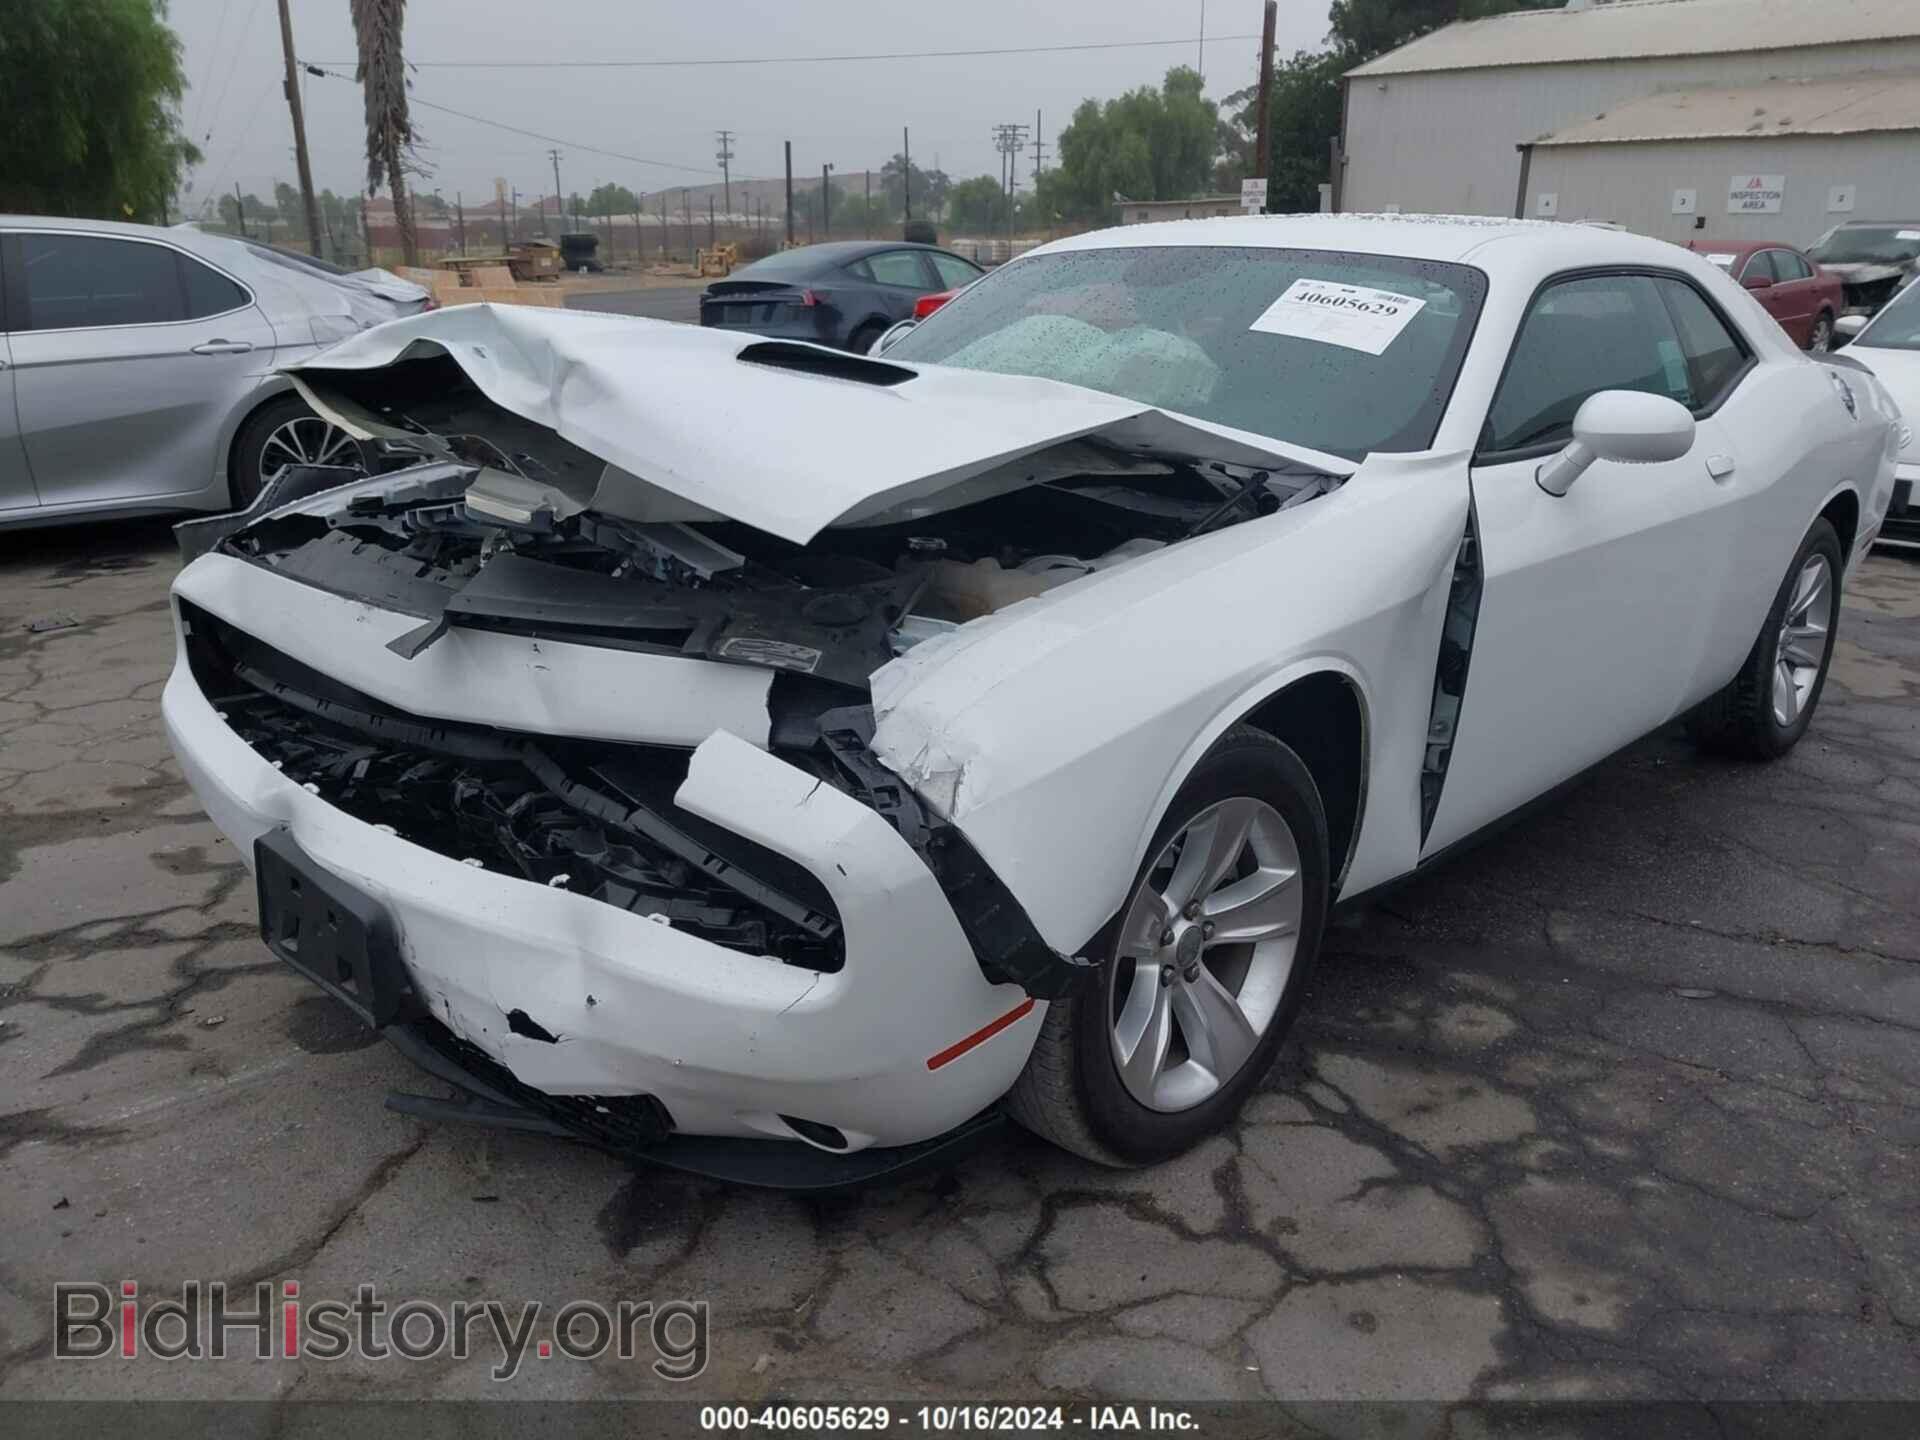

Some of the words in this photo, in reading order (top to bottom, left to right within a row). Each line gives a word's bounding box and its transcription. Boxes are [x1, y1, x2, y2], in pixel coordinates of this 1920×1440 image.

[1730, 191, 1781, 201] INSPECTION
[1741, 200, 1765, 209] AREA
[1295, 291, 1399, 317] 40605629
